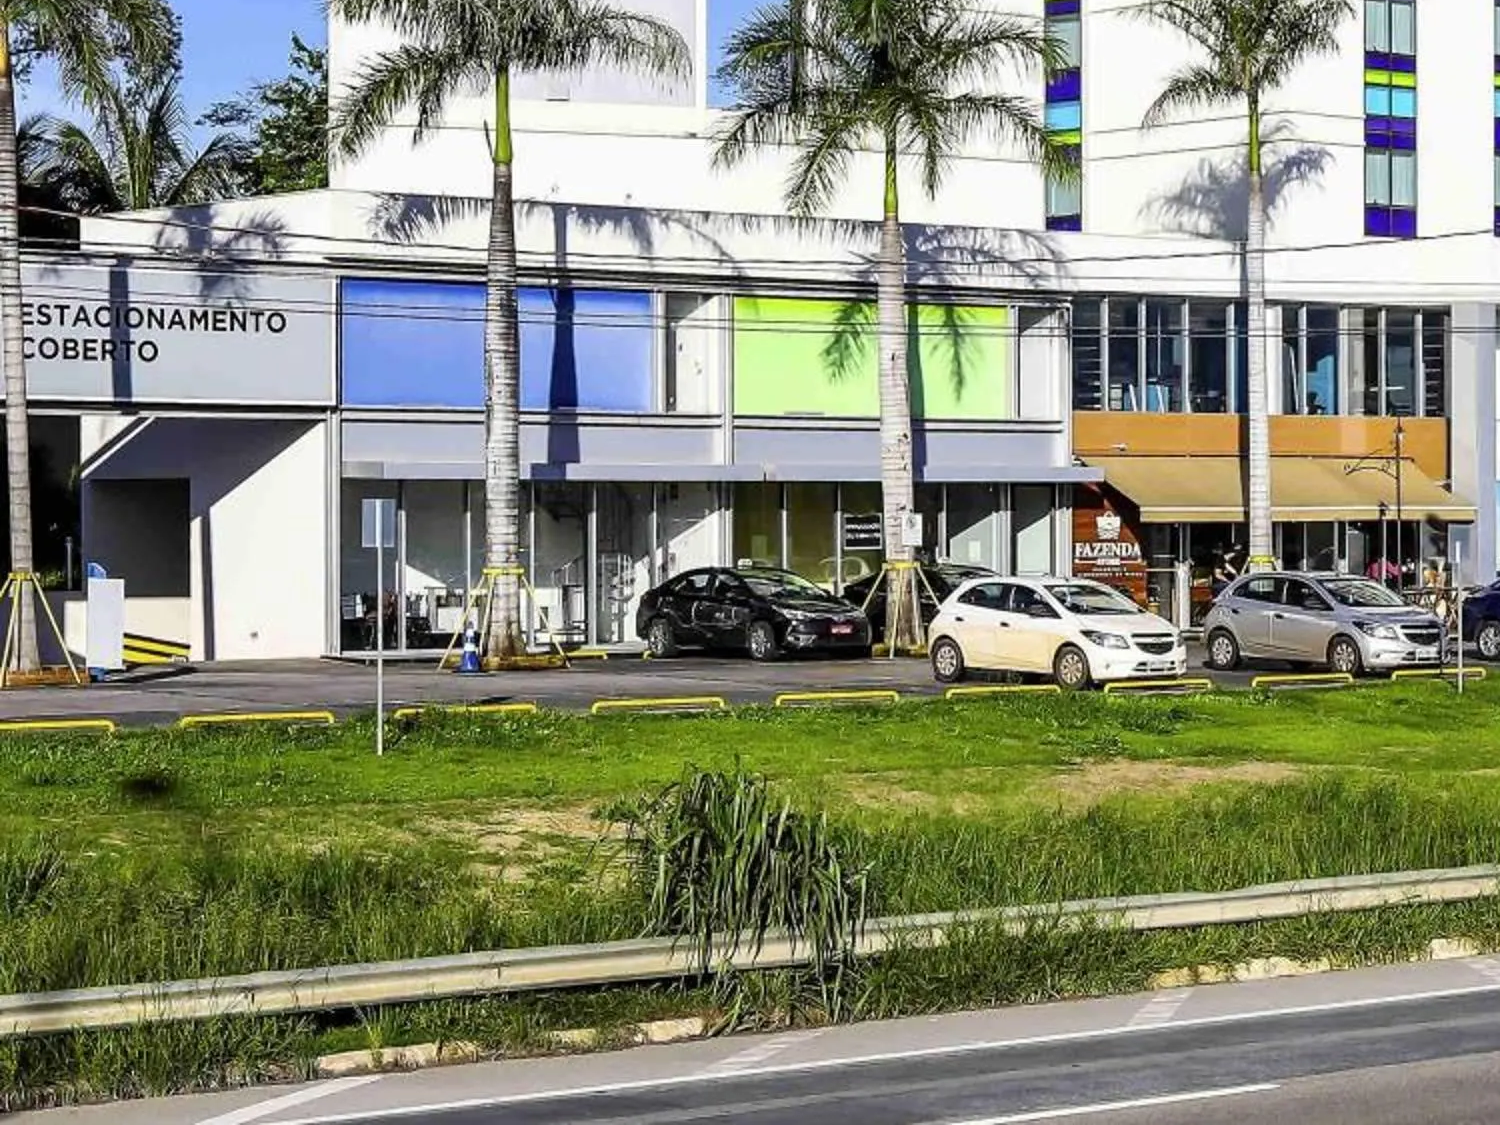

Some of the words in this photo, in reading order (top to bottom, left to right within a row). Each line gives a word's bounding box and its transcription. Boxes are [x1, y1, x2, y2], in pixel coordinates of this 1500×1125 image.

[21, 303, 287, 333] ESTACIONAMENTO
[22, 336, 159, 363] COBERTO
[1074, 542, 1142, 558] FAZENDA
